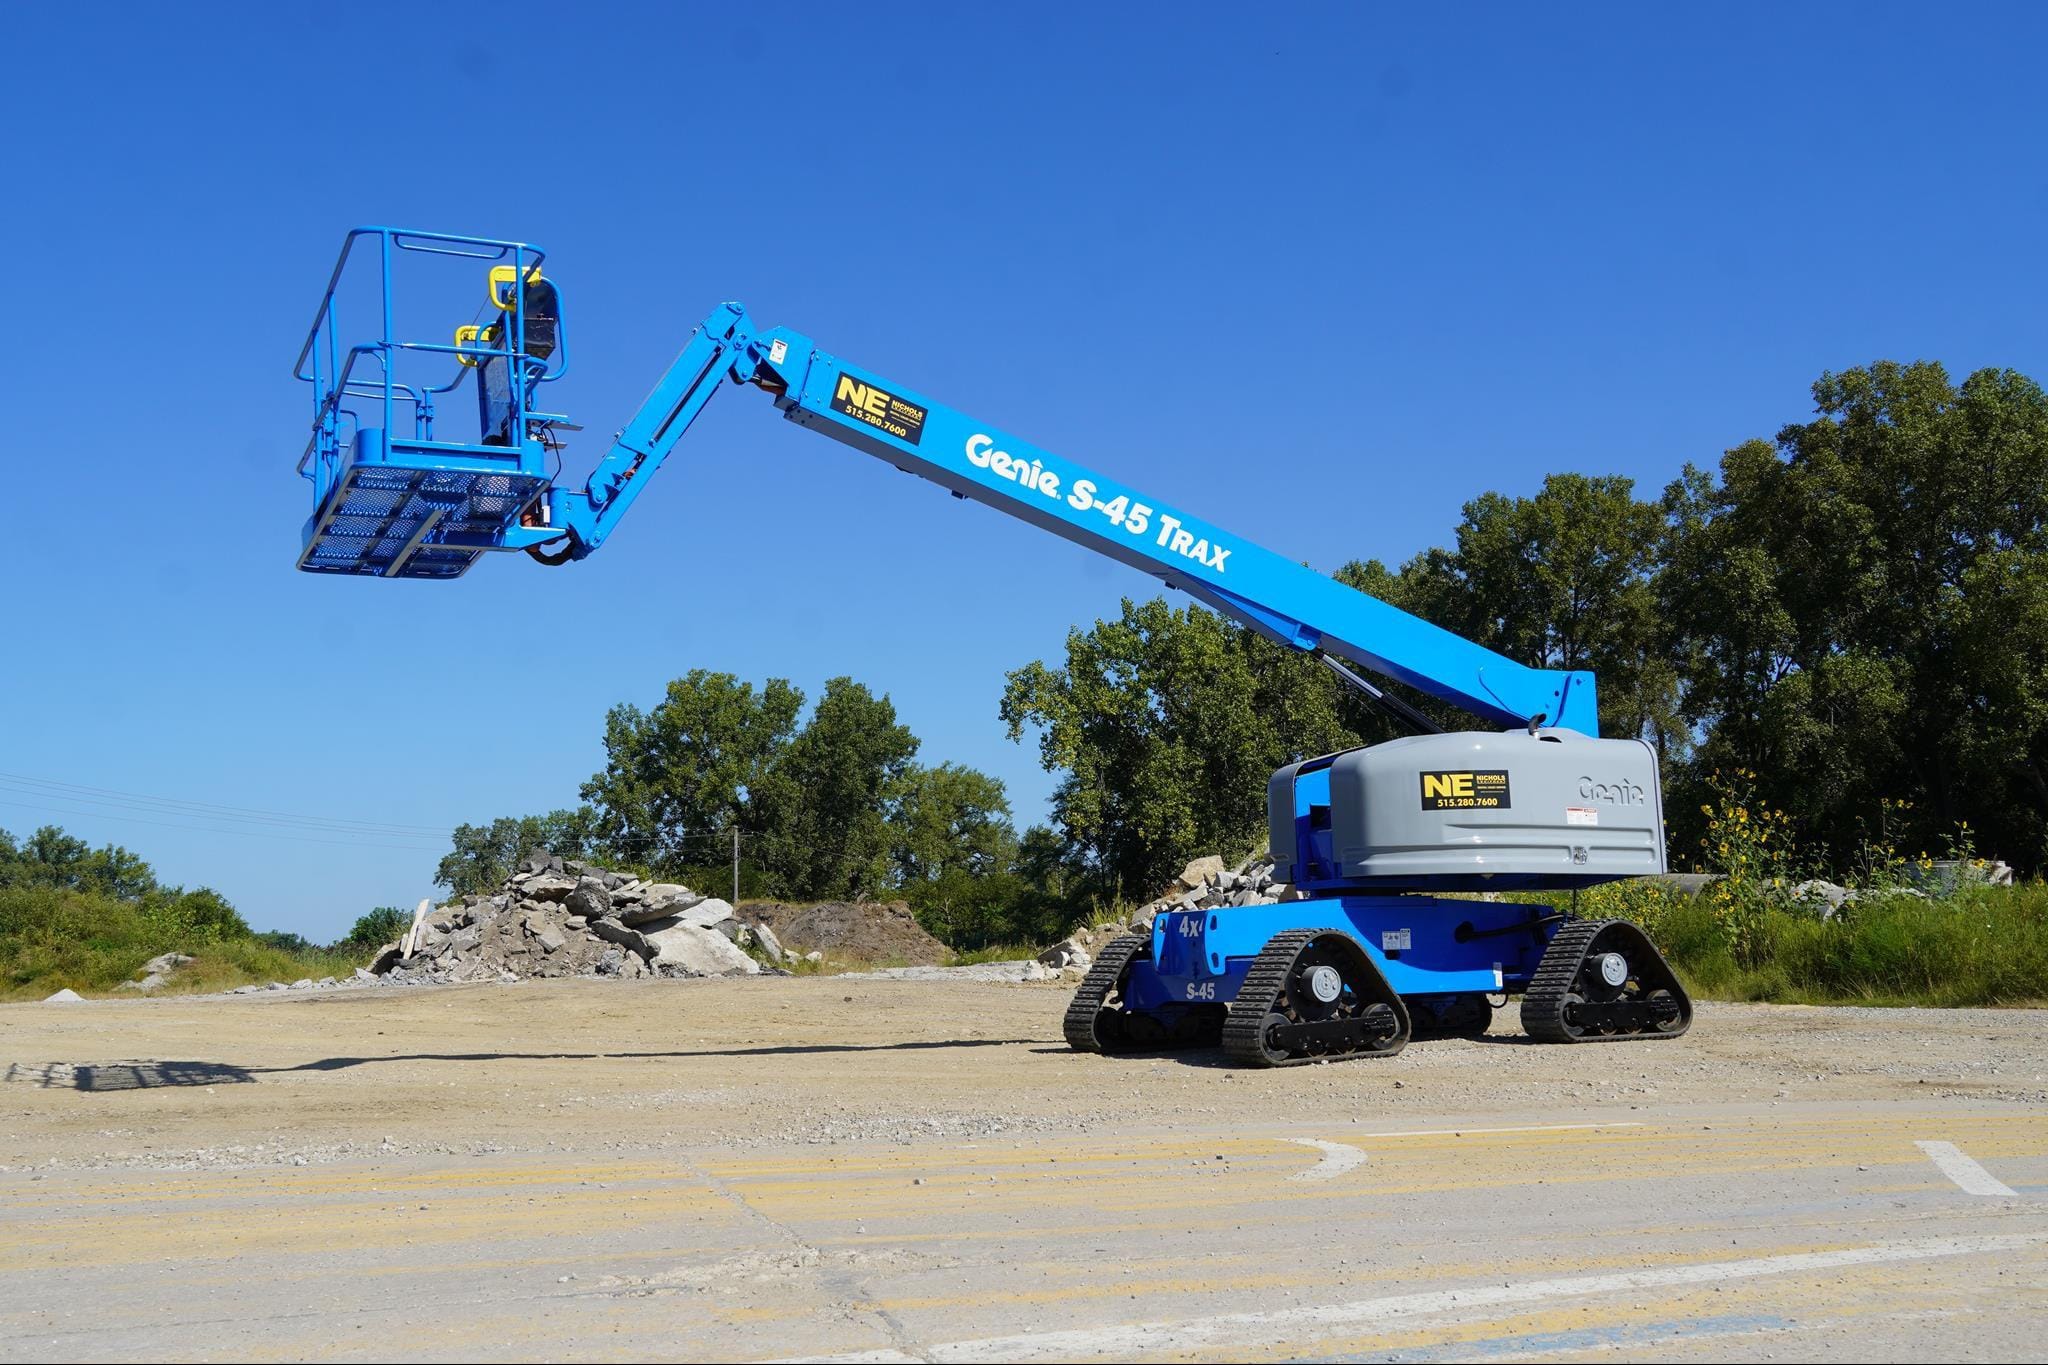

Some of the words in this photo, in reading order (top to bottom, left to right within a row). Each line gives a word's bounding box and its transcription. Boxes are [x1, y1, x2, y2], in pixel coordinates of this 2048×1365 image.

[837, 376, 890, 417] NE
[845, 405, 906, 437] 515.280.7600
[965, 433, 1060, 499] Genie
[1067, 479, 1153, 534] S-45
[1424, 774, 1475, 798] NE
[1577, 776, 1644, 806] Genie
[1437, 798, 1498, 807] 515.280.7600
[1186, 982, 1215, 1000] S-45
